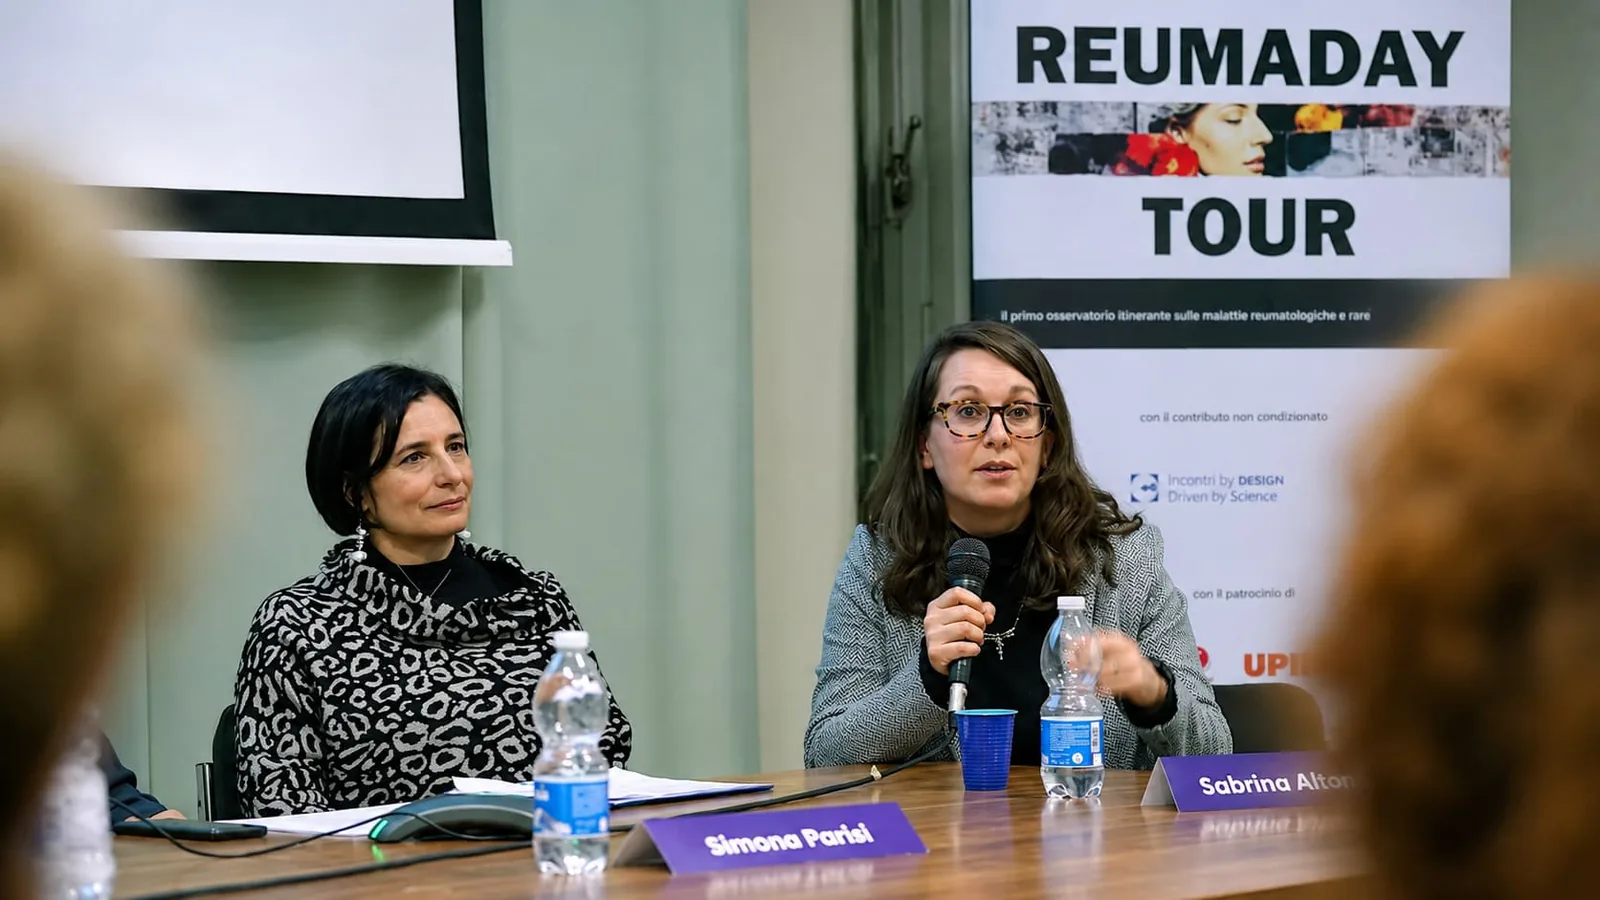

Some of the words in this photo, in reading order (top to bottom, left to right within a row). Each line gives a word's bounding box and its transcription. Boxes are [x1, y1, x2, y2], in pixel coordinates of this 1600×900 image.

[1016, 26, 1465, 87] REUMADAY
[1142, 197, 1356, 256] TOUR
[1010, 310, 1044, 323] primo
[1046, 310, 1116, 321] osservatorio
[1118, 310, 1172, 321] itinerante
[1174, 310, 1200, 321] sulle
[1202, 310, 1248, 321] malattie
[1251, 310, 1337, 323] reumatologiche
[1339, 312, 1346, 321] e
[1349, 311, 1371, 321] rare
[1140, 413, 1160, 423] con
[1163, 411, 1170, 422] il
[1172, 412, 1230, 422] contributo
[1233, 413, 1254, 422] non
[1257, 412, 1328, 422] condizionato
[1168, 474, 1216, 486] Incontri
[1219, 474, 1234, 488] by
[1239, 475, 1284, 485] DESIGN
[1168, 491, 1208, 502] Driven
[1212, 491, 1227, 504] by
[1230, 491, 1278, 502] Science
[1192, 590, 1213, 599] con
[1216, 588, 1222, 599] il
[1225, 588, 1282, 601] patrocinio
[1285, 588, 1295, 598] di
[1199, 773, 1291, 796] Sabrina
[705, 834, 803, 857] Simona
[805, 822, 874, 850] Parisi
